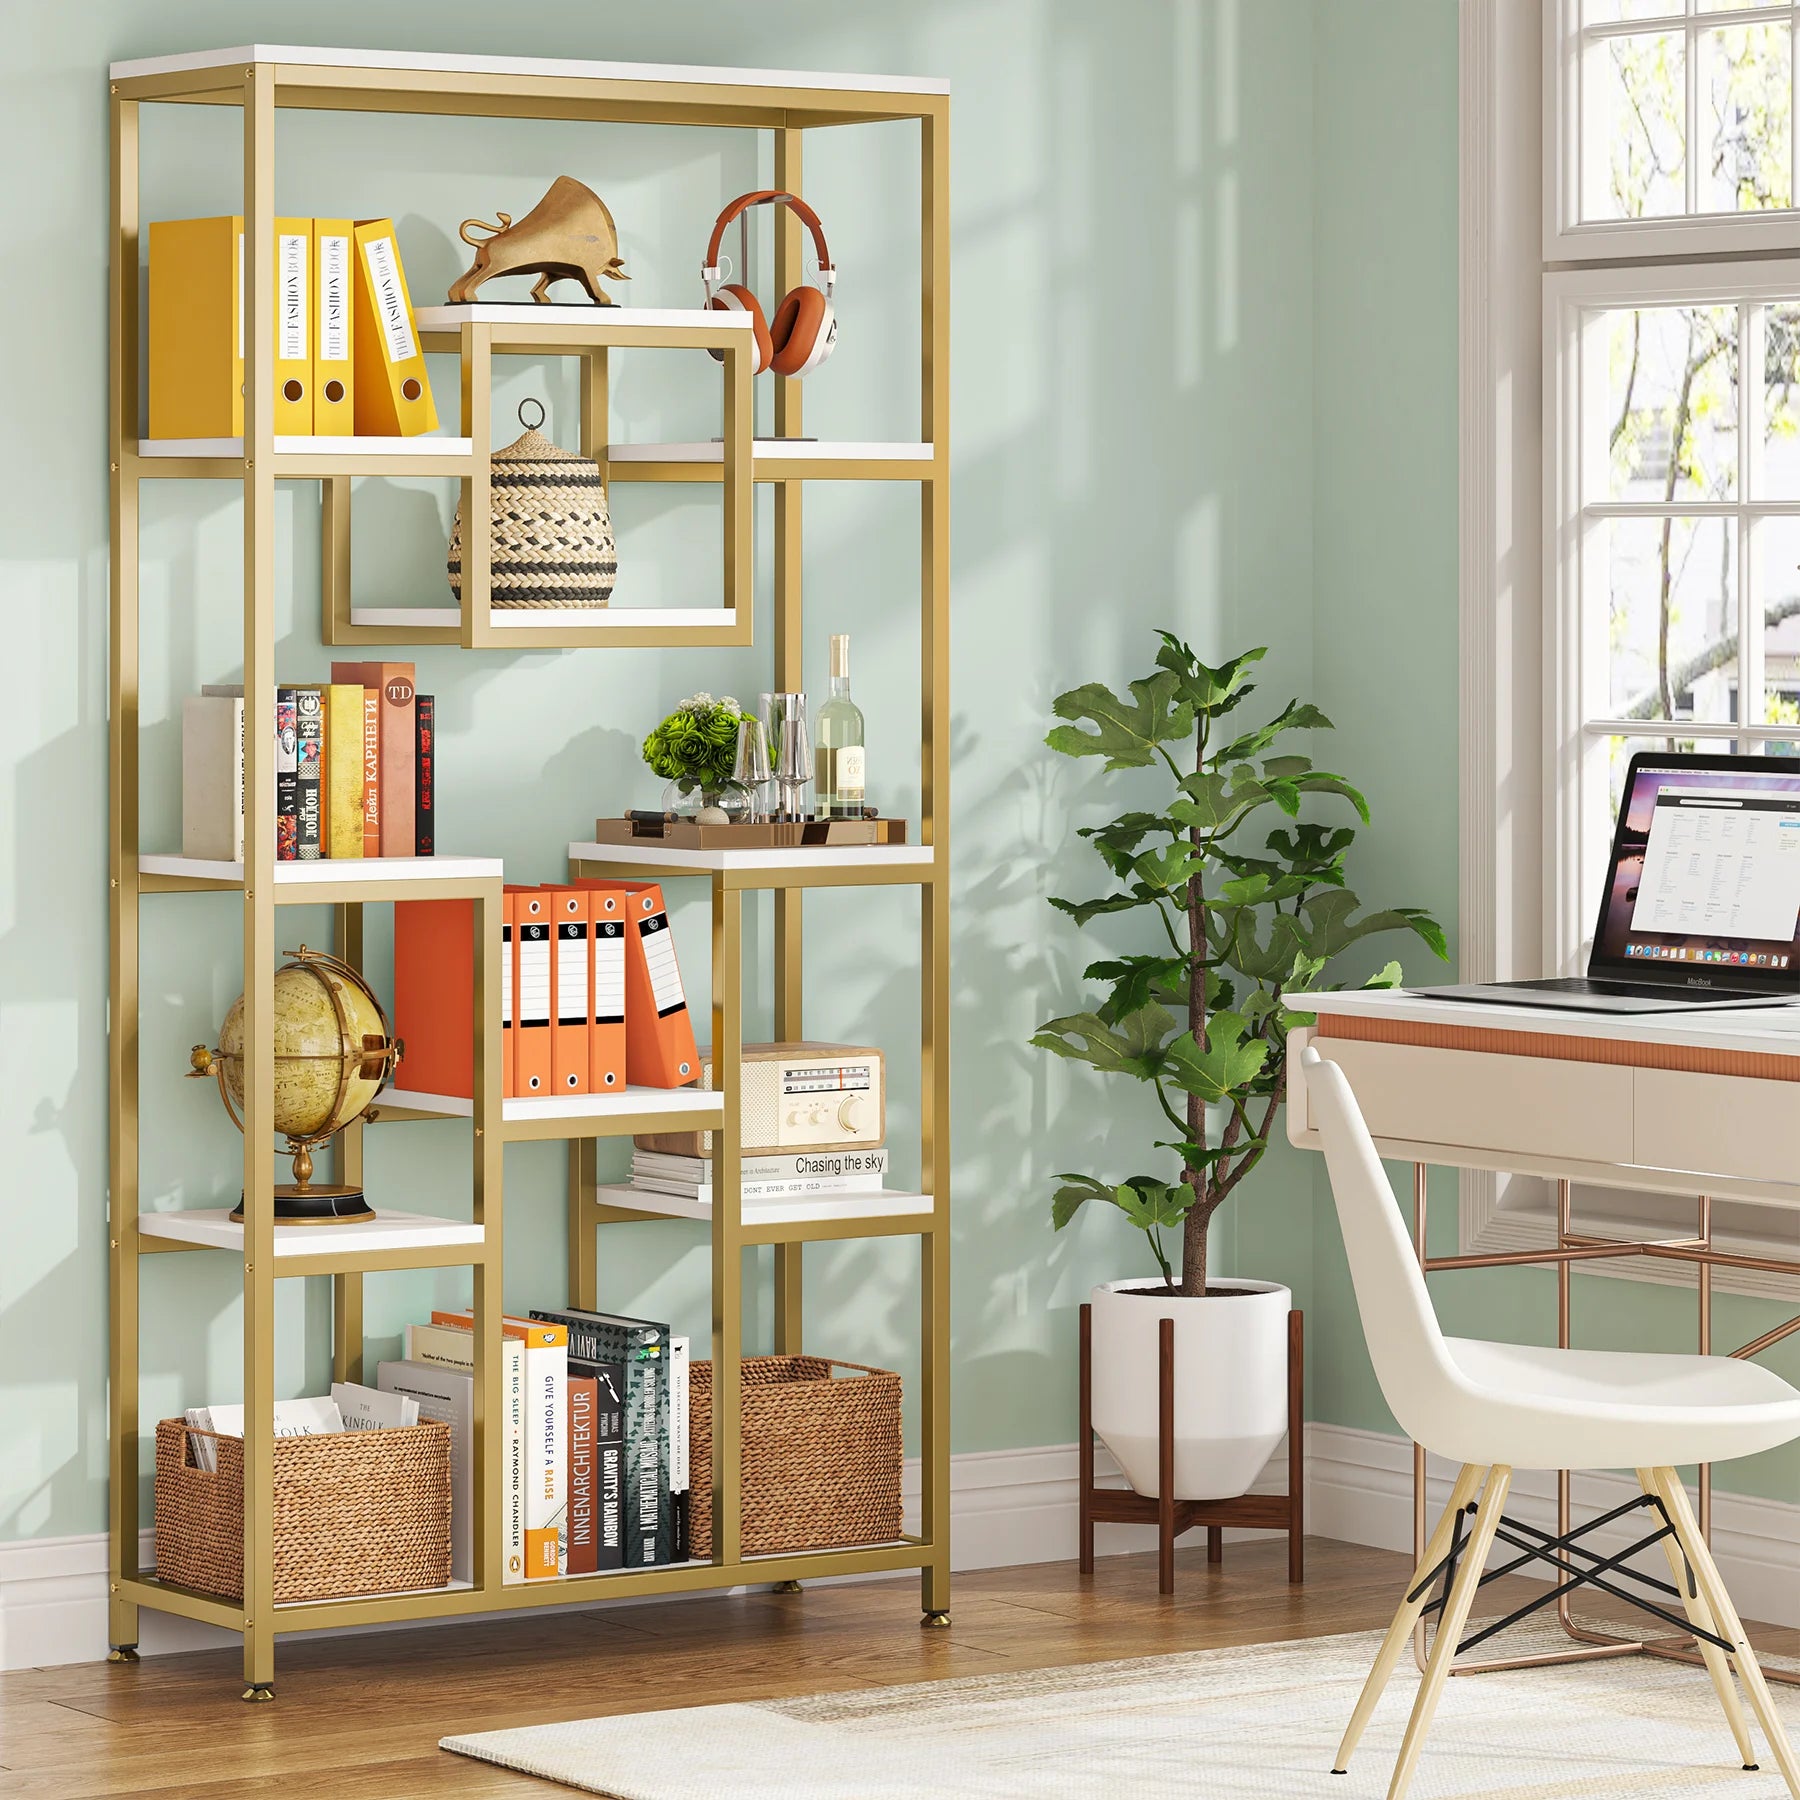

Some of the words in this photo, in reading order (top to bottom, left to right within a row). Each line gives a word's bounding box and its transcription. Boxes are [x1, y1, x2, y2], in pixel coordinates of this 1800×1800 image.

[287, 238, 299, 273] BOOK
[329, 239, 340, 274] BOOK
[373, 242, 390, 277] BOOK
[287, 276, 299, 329] FASHION
[329, 277, 340, 330] FASHION
[382, 279, 403, 331] FASHION
[287, 331, 299, 357] THE
[329, 332, 340, 358] THE
[394, 331, 409, 359] THE
[388, 686, 412, 700] TD
[365, 698, 377, 783] КАРНЕГИ
[305, 788, 318, 838] ЛОНДОН
[366, 787, 378, 825] Дейл
[1686, 977, 1711, 987] MacBook
[795, 1157, 841, 1175] Chasing
[844, 1155, 862, 1171] the
[865, 1153, 884, 1172] sky
[766, 1185, 785, 1193] EVER
[806, 1182, 821, 1190] OLD
[577, 1335, 597, 1360] RAVI
[545, 1375, 554, 1400] GIVE
[359, 1403, 370, 1412] THE
[611, 1411, 619, 1433] THOMAS
[545, 1403, 554, 1455] YOURSELF
[600, 1412, 609, 1437] PYNCHON
[573, 1391, 591, 1546] INNENARCHITEKTUR
[640, 1440, 658, 1468] MOSAIC
[544, 1469, 554, 1500] RAISE
[640, 1468, 658, 1525] MATHEMATICAL
[603, 1501, 618, 1547] RAINBOW
